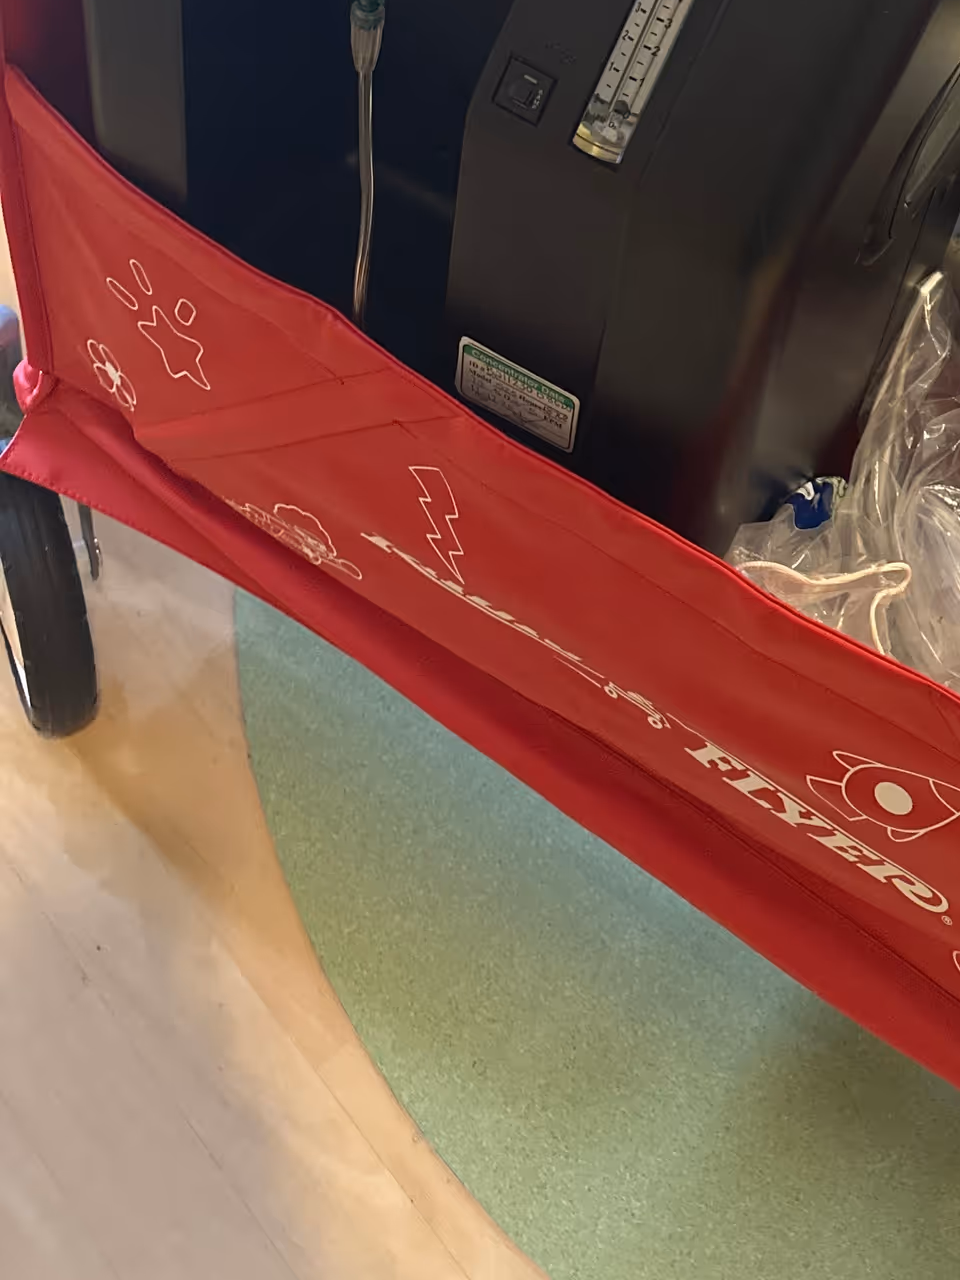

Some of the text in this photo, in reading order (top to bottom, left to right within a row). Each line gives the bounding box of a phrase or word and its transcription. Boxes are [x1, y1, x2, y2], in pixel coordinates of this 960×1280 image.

[665, 18, 673, 29] 3
[622, 30, 629, 40] 2
[652, 46, 660, 56] 2
[684, 740, 950, 915] FLYER
